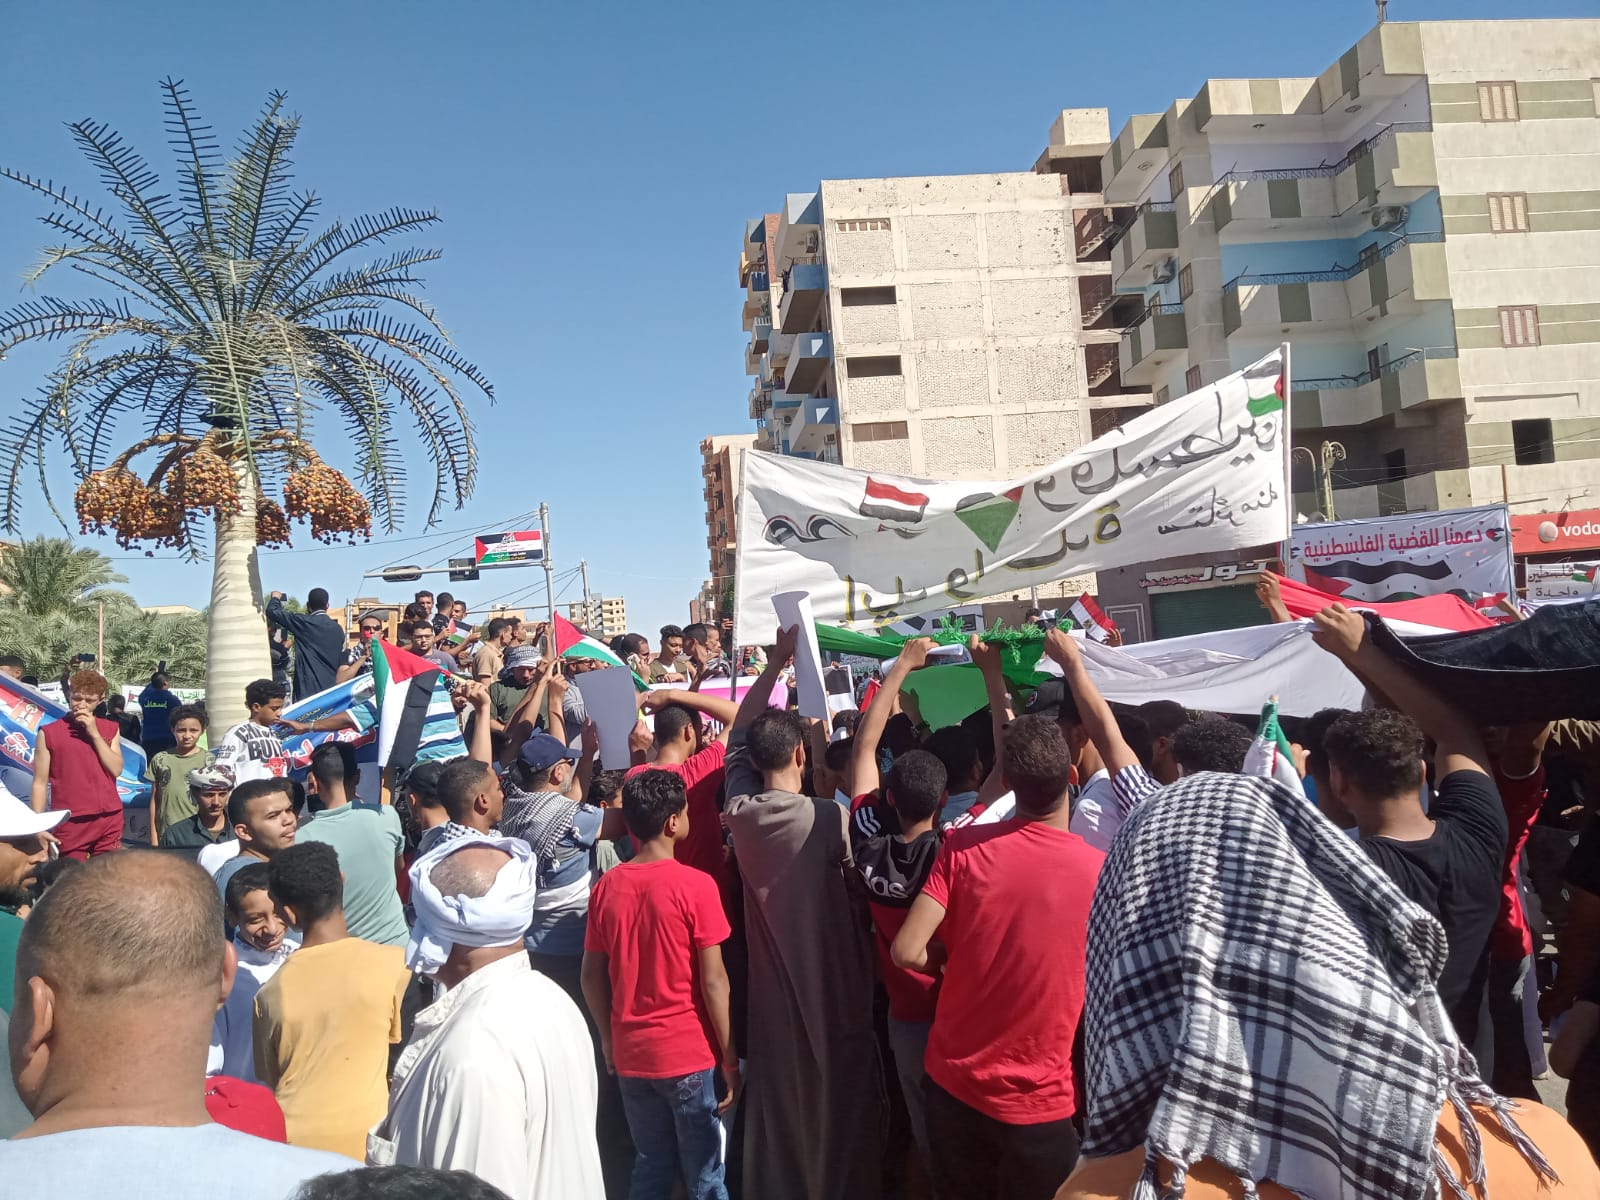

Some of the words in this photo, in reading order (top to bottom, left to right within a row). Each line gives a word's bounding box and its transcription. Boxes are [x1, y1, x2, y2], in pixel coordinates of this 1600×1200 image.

[1304, 533, 1384, 562] الفلسطينية
[1388, 527, 1440, 555] للقضية
[1443, 527, 1484, 546] دعمنا
[1528, 564, 1574, 583] فلسطين
